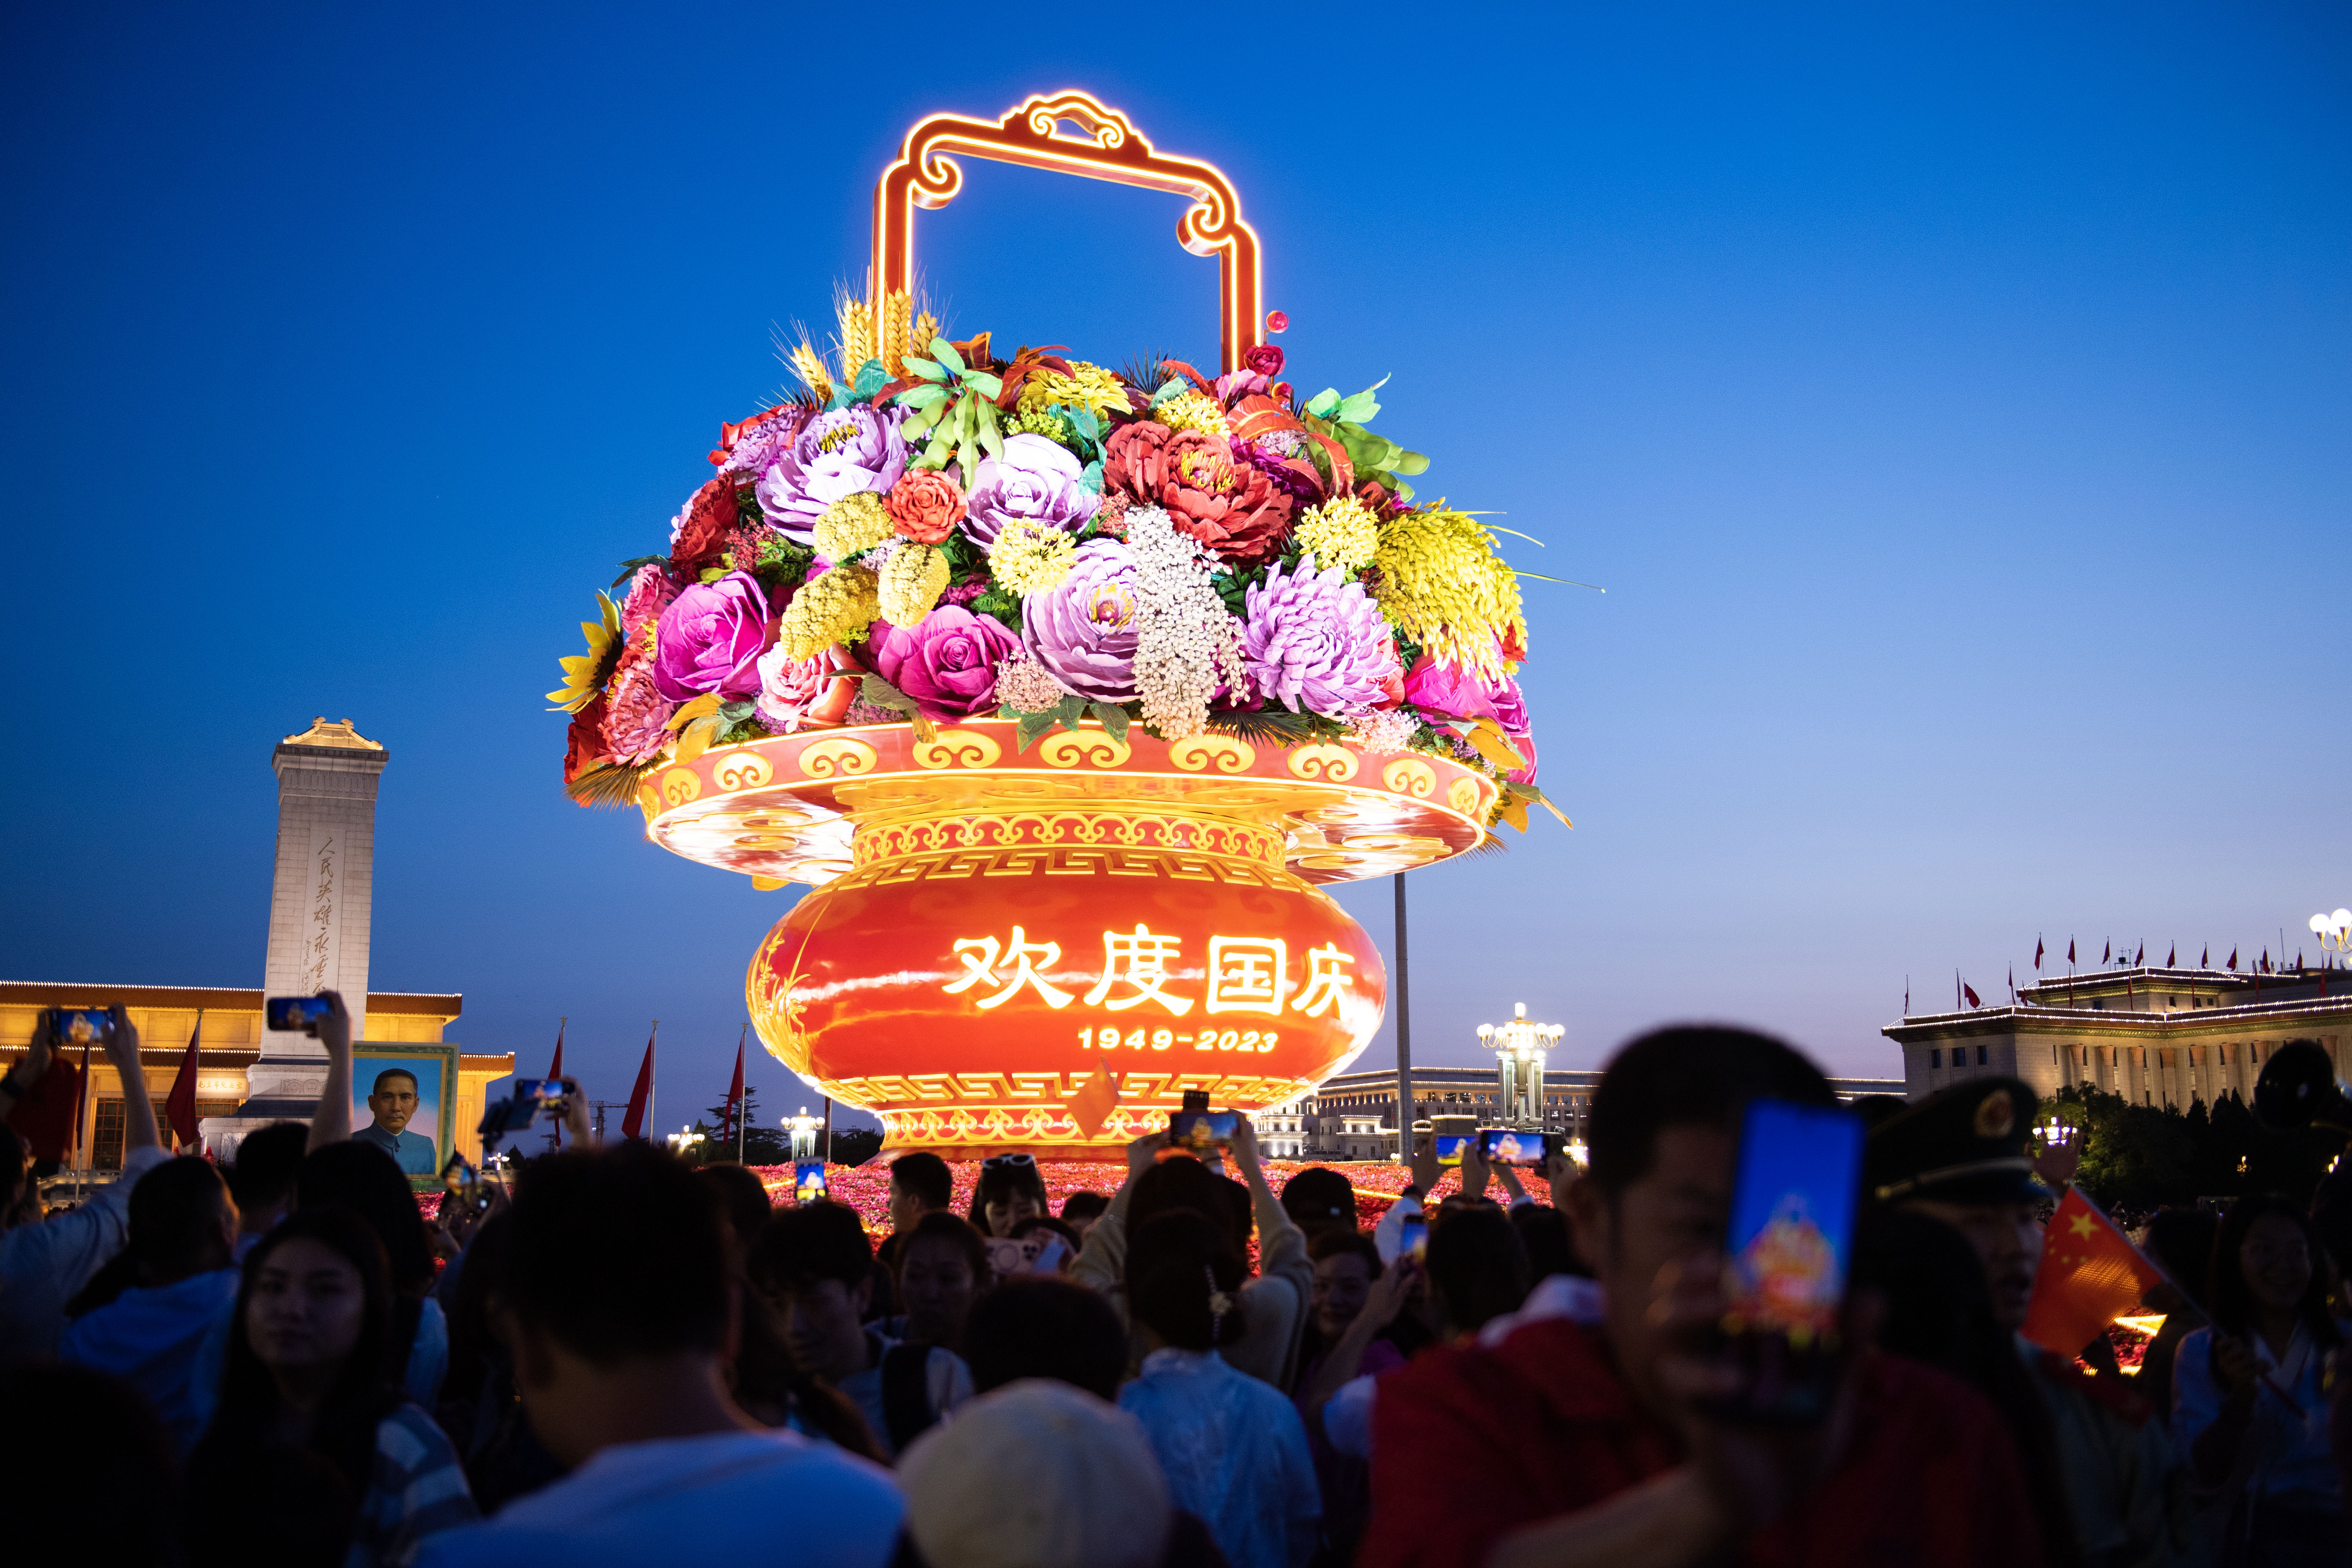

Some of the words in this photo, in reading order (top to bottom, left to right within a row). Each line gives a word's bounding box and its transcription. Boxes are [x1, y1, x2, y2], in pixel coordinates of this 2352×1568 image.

[941, 923, 1355, 1022] 欢度国庆
[1078, 1026, 1278, 1053] 1949-2023
